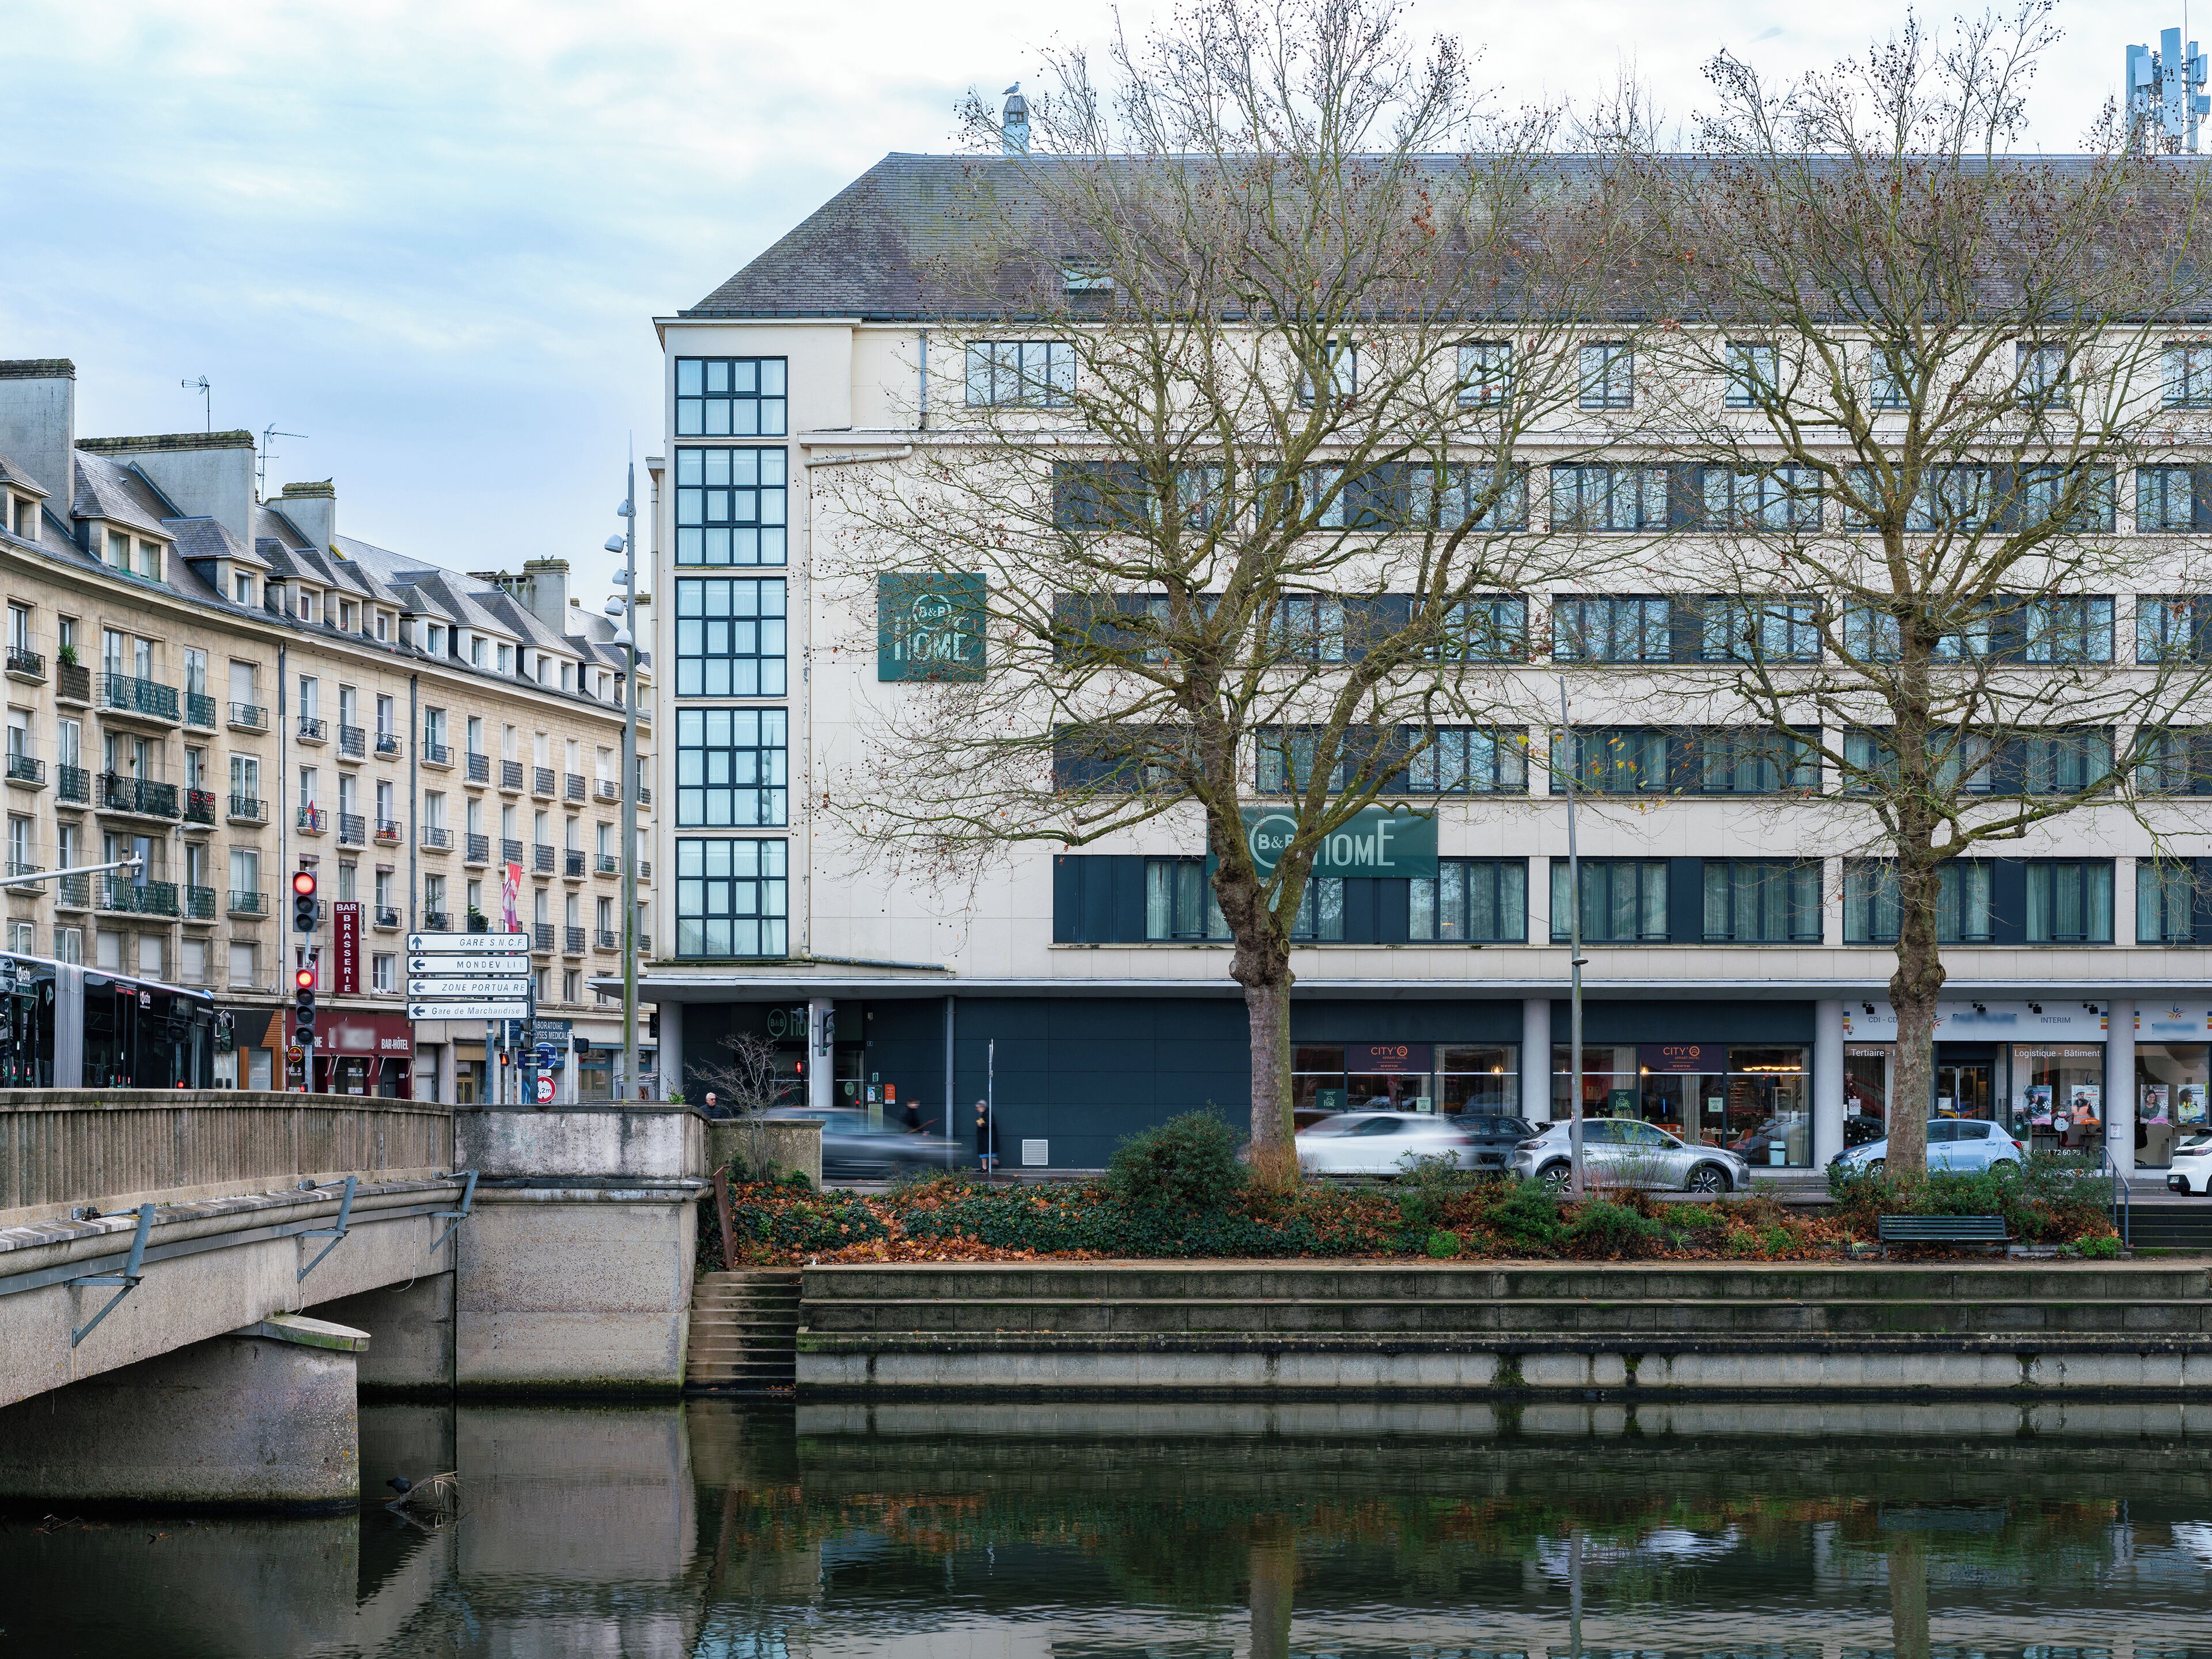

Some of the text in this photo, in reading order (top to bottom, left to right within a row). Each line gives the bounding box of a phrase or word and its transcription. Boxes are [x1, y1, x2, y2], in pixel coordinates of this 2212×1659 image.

[1313, 819, 1396, 866] OME
[343, 915, 351, 991] BRASSERIE
[770, 1018, 785, 1027] B&B
[381, 1036, 409, 1050] BAR-HÔTEL
[1850, 1048, 1884, 1056] Tertiaire
[2014, 1049, 2056, 1059] Logistique
[2064, 1049, 2100, 1057] Bâtiment
